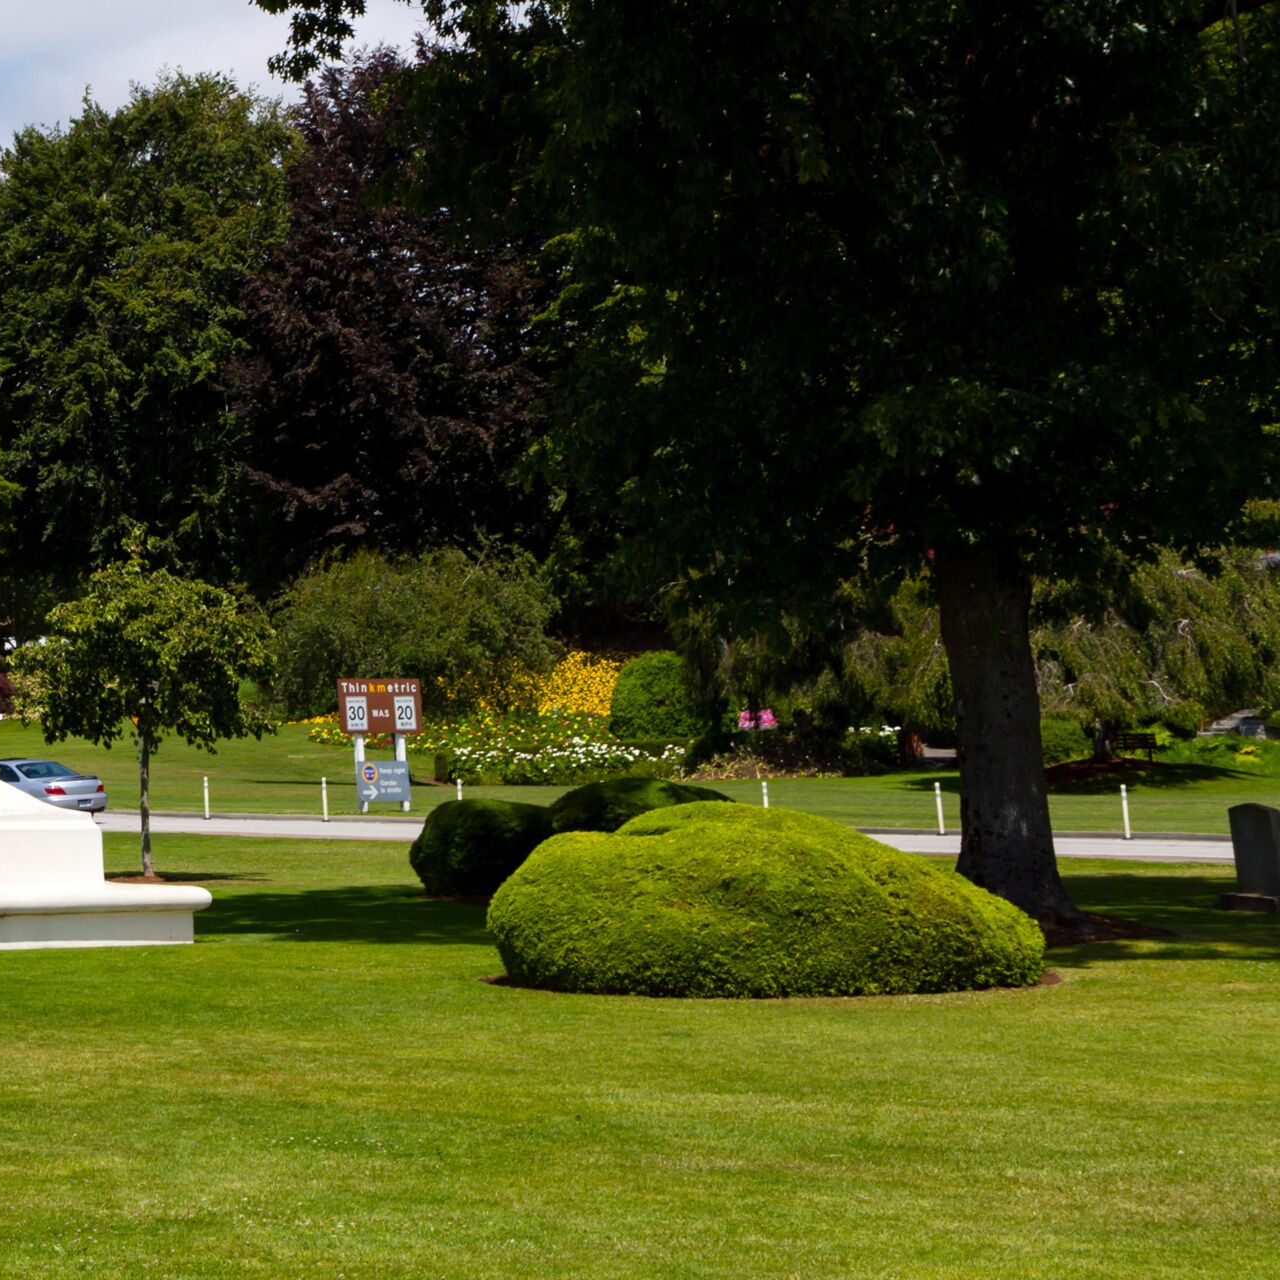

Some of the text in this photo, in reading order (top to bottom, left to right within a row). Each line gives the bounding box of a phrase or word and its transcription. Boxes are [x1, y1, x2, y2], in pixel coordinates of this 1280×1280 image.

[349, 705, 412, 720] 30 WAS 20
